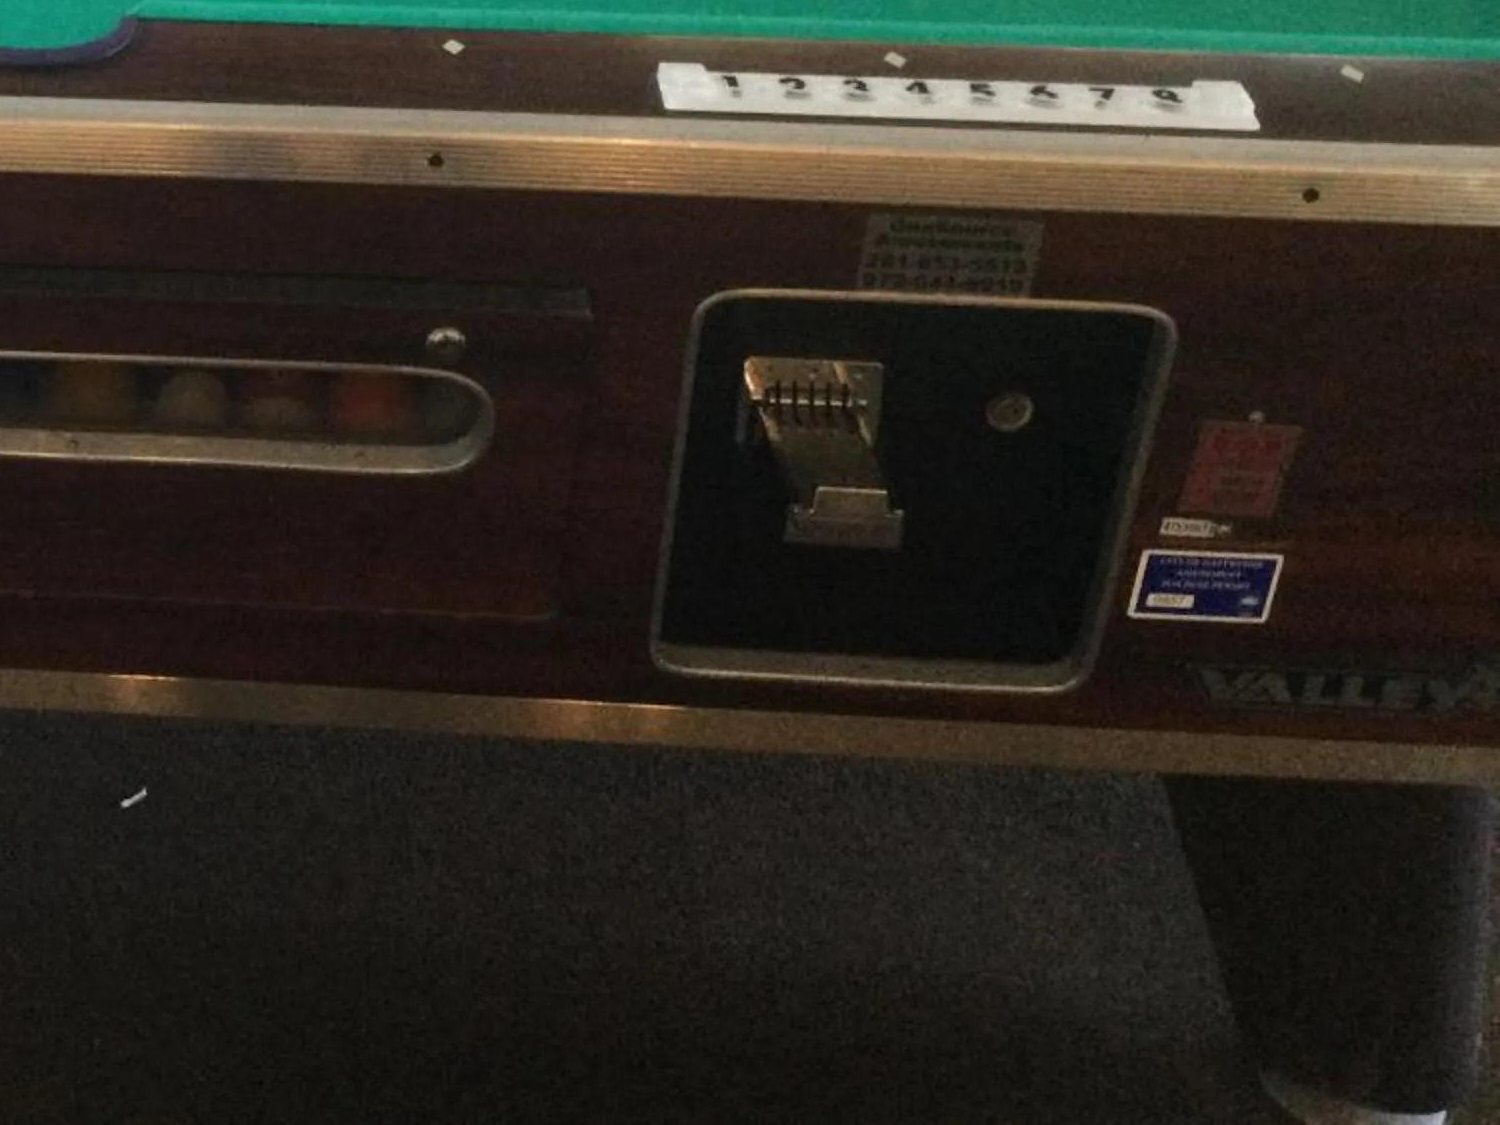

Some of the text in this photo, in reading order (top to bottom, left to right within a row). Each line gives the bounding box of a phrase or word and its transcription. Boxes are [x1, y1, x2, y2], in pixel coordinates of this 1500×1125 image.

[722, 75, 742, 98] 1
[778, 77, 810, 100] 2
[844, 78, 874, 102] 3
[906, 80, 936, 104] 4
[969, 82, 999, 107] 5
[1027, 85, 1060, 108] 6
[1089, 87, 1116, 109] 7
